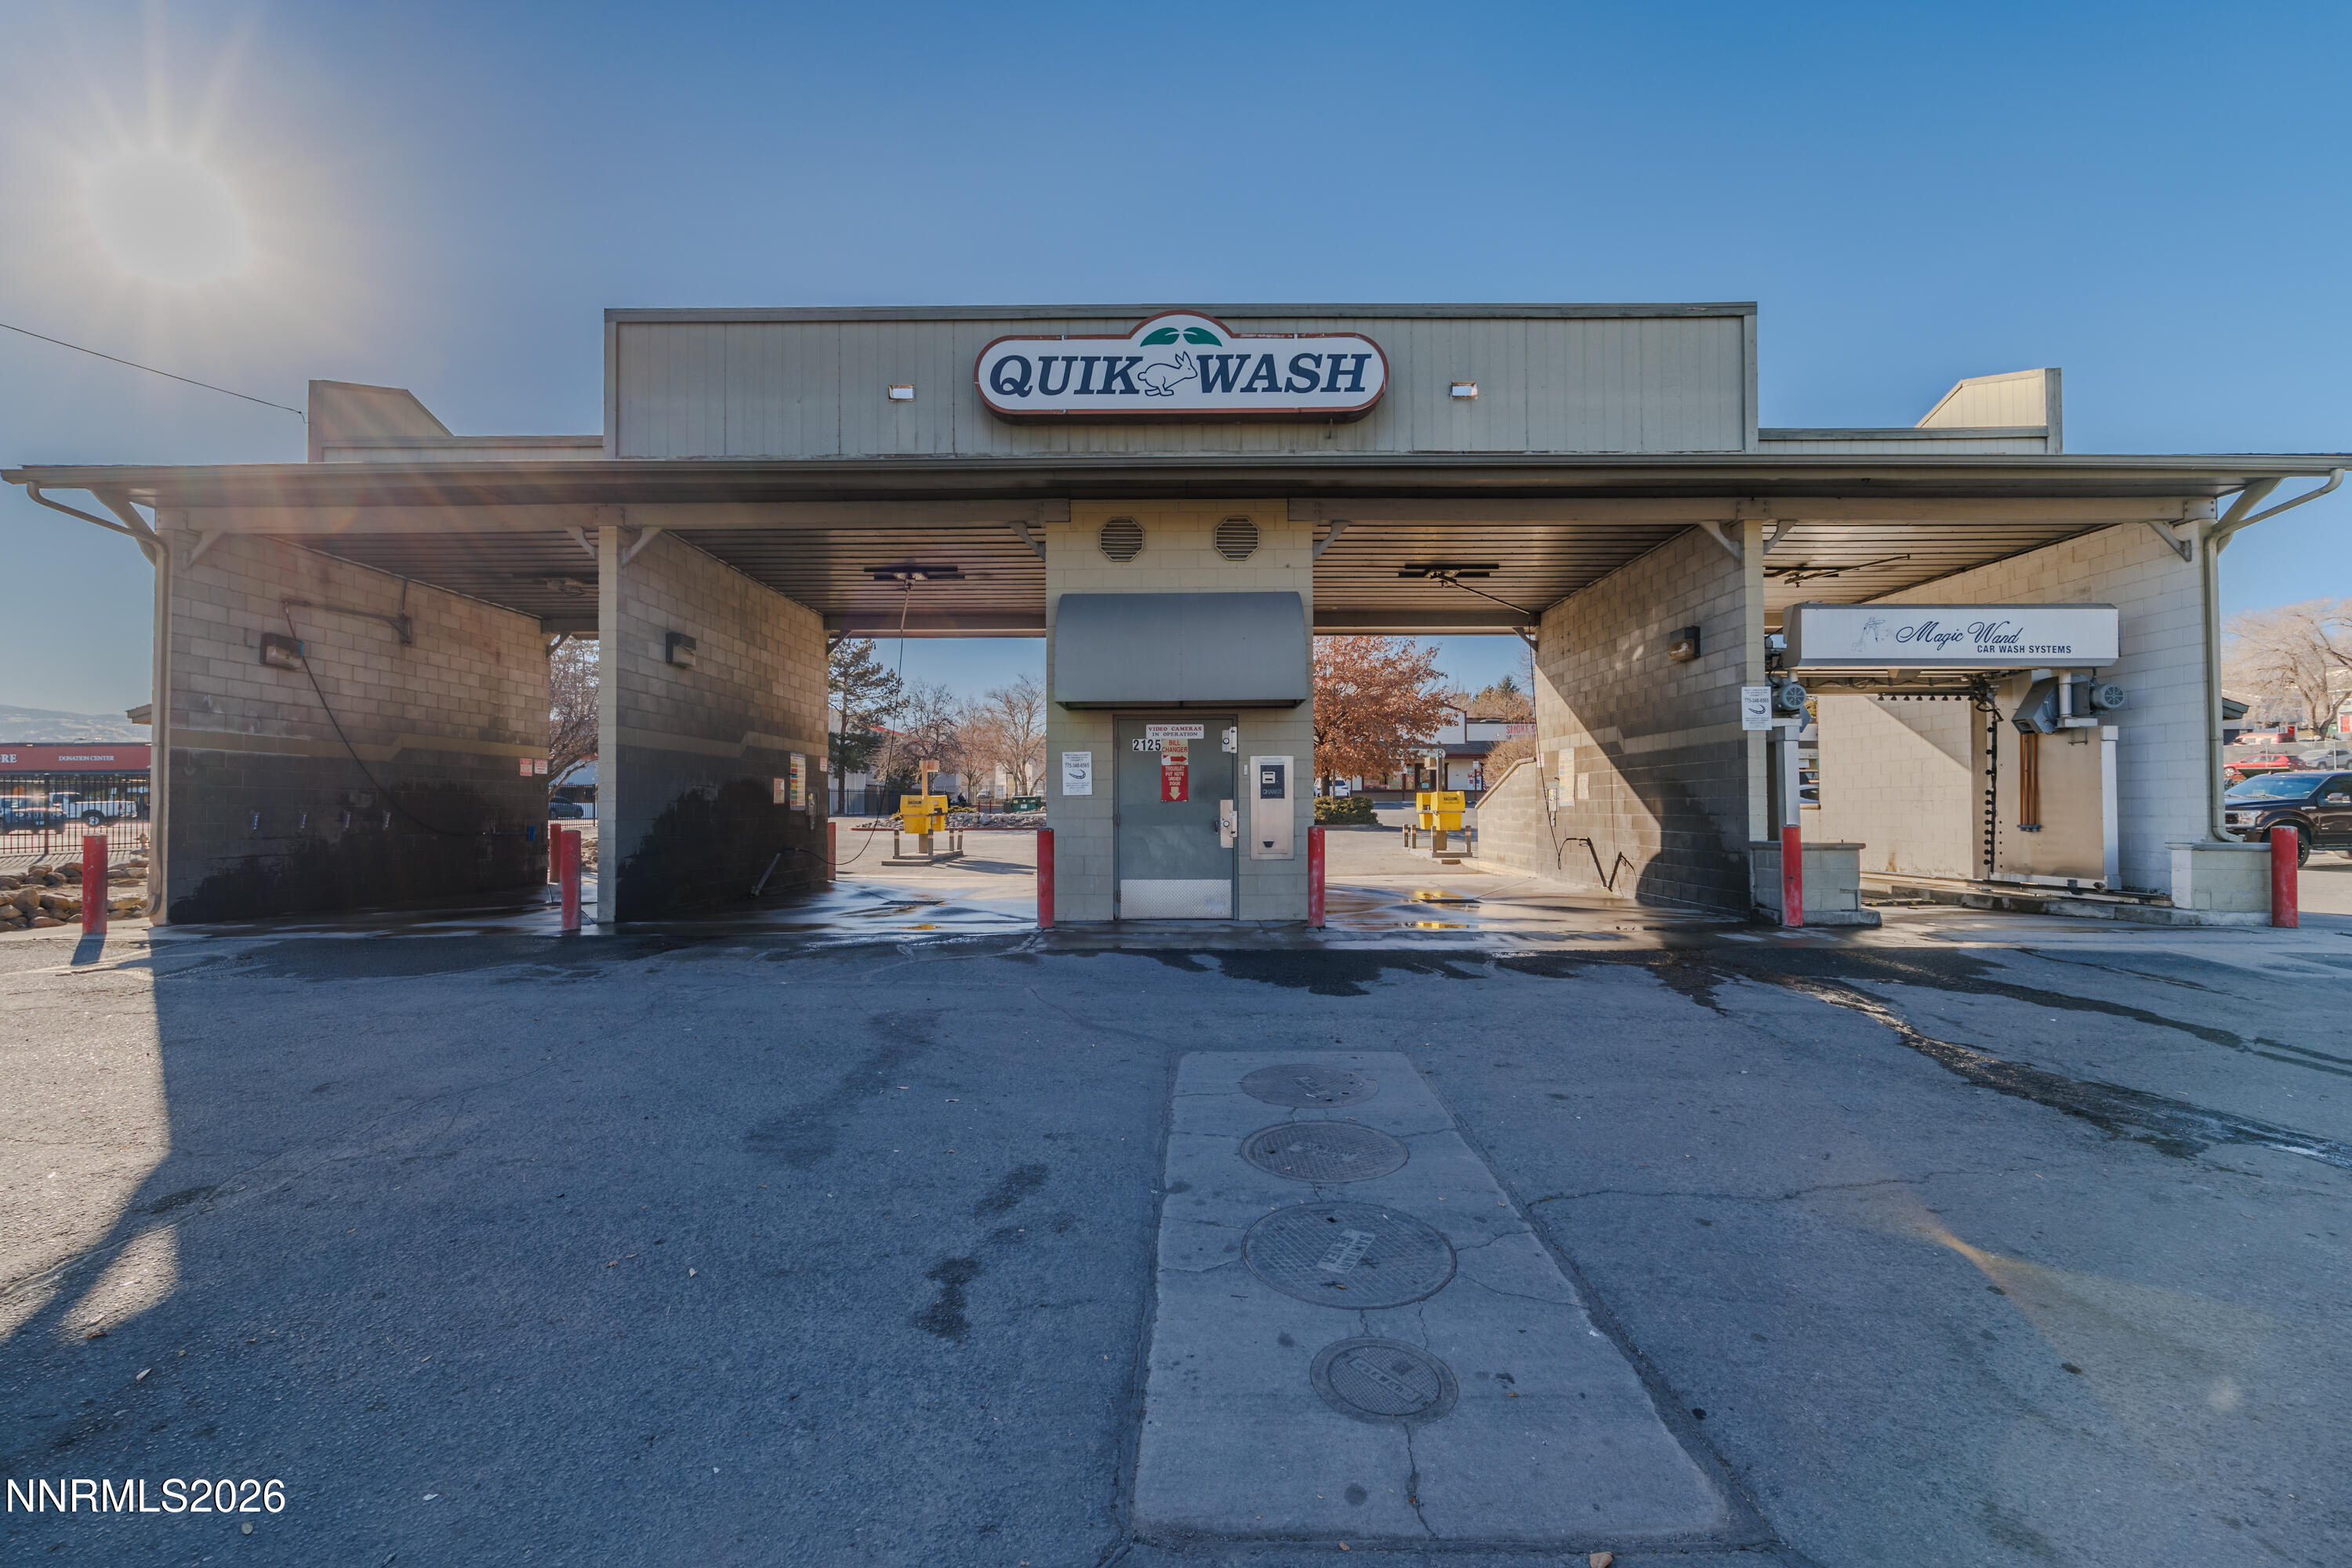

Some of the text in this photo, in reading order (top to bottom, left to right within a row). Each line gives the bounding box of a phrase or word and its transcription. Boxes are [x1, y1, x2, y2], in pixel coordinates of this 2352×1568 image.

[989, 353, 1372, 397] QUIK WASH
[1896, 621, 2024, 651] Magic Wand
[2029, 645, 2071, 654] SYSTEMS
[1134, 739, 1160, 751] 2125
[0, 753, 17, 764] RE
